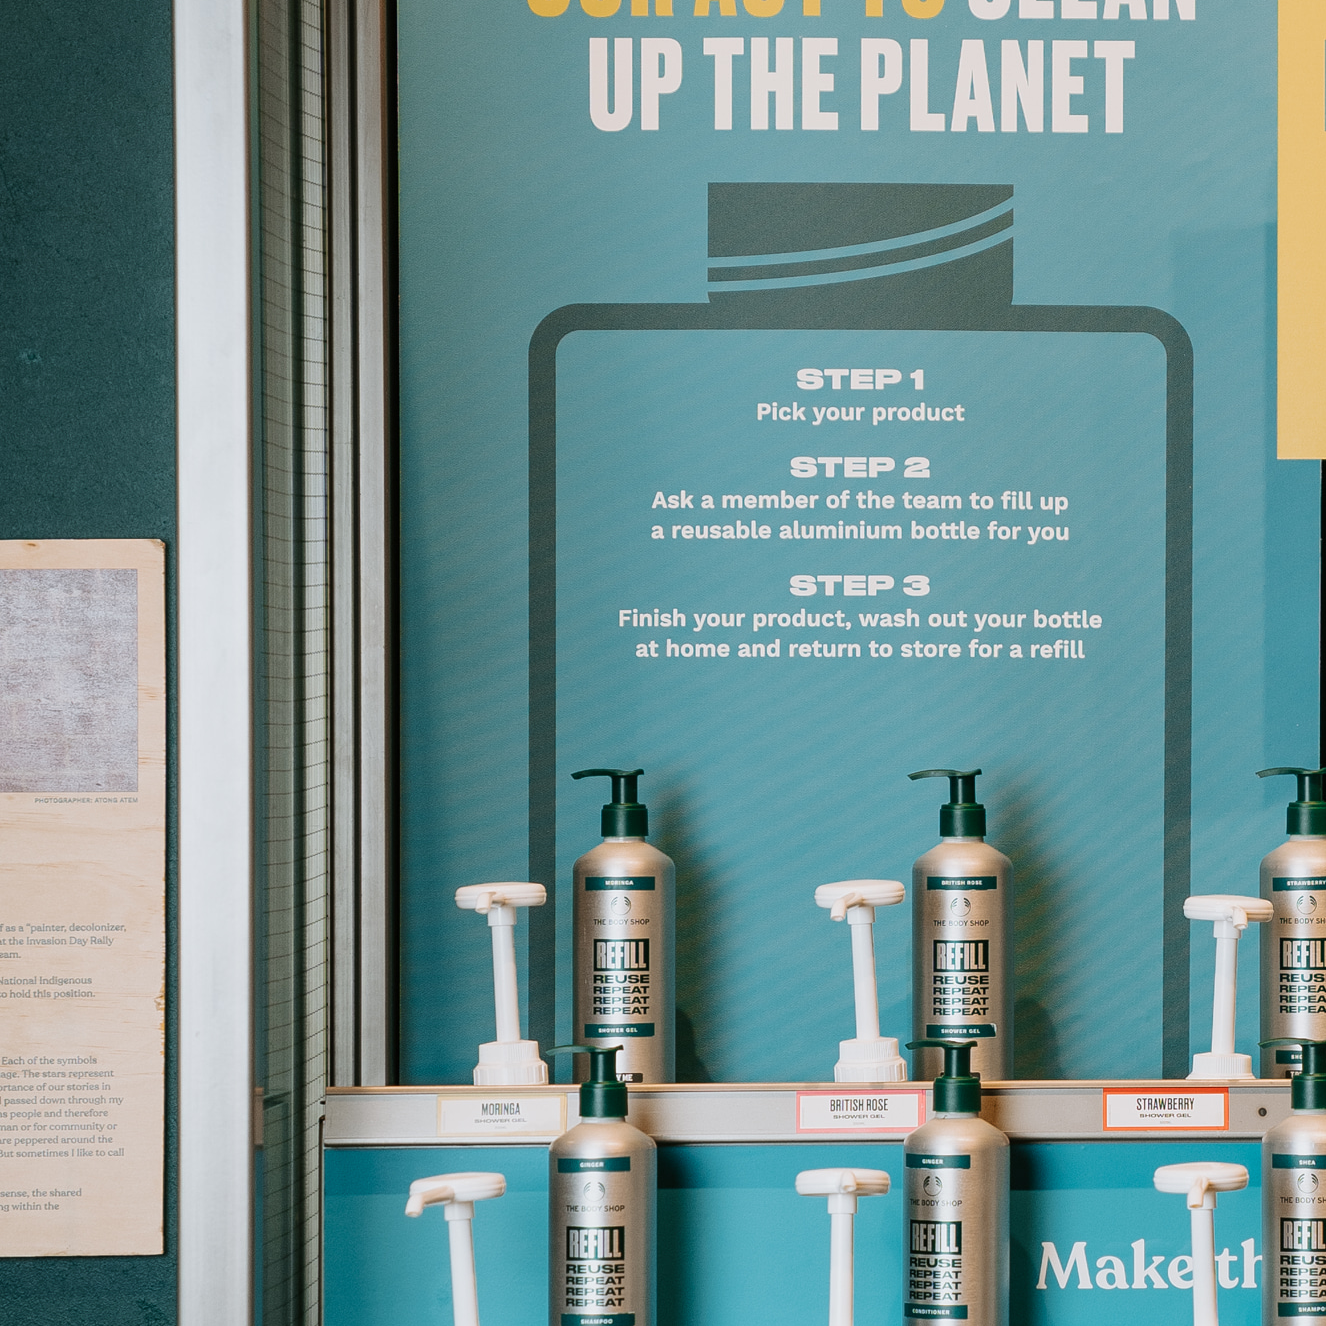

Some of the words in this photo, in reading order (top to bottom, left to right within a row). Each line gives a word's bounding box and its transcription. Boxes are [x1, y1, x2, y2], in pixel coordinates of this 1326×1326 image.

[589, 37, 683, 132] UP
[703, 37, 839, 131] THE
[860, 37, 1136, 134] PLANET
[796, 368, 903, 390] STEP
[909, 368, 924, 391] 1
[757, 401, 807, 421] Pick
[812, 406, 866, 426] your
[872, 402, 966, 426] product
[790, 456, 896, 478] STEP
[903, 456, 931, 479] 2
[651, 489, 694, 509] Ask
[700, 494, 715, 509] a
[722, 489, 820, 509] member
[825, 489, 851, 509] of
[855, 489, 895, 509] the
[901, 491, 962, 510] team
[968, 492, 994, 510] to
[1000, 490, 1034, 510] fill
[1040, 496, 1069, 516] up
[651, 525, 665, 540] a
[672, 520, 772, 540] reusable
[779, 520, 903, 540] aluminium
[911, 520, 981, 540] bottle
[986, 520, 1022, 540] for
[1027, 526, 1069, 545] you
[789, 574, 895, 597] STEP
[902, 574, 931, 597] 3
[619, 608, 686, 627] Finish
[693, 613, 746, 632] your
[753, 608, 852, 632] product,
[858, 608, 920, 628] wash
[928, 610, 968, 628] out
[973, 613, 1027, 633] your
[1033, 609, 1103, 629] bottle
[635, 640, 659, 658] at
[666, 638, 731, 658] home
[737, 638, 781, 658] and
[789, 640, 861, 658] return
[868, 640, 893, 658] to
[900, 640, 962, 658] store
[968, 638, 1003, 658] for
[1009, 644, 1024, 659] a
[1030, 639, 1086, 659] refill
[481, 1102, 521, 1116] MORINGA
[829, 1099, 864, 1112] BRITISH
[866, 1098, 888, 1111] ROSE
[1136, 1097, 1195, 1111] STRAWBERRY
[1035, 1238, 1195, 1290] Make
[1214, 1237, 1263, 1289] th
